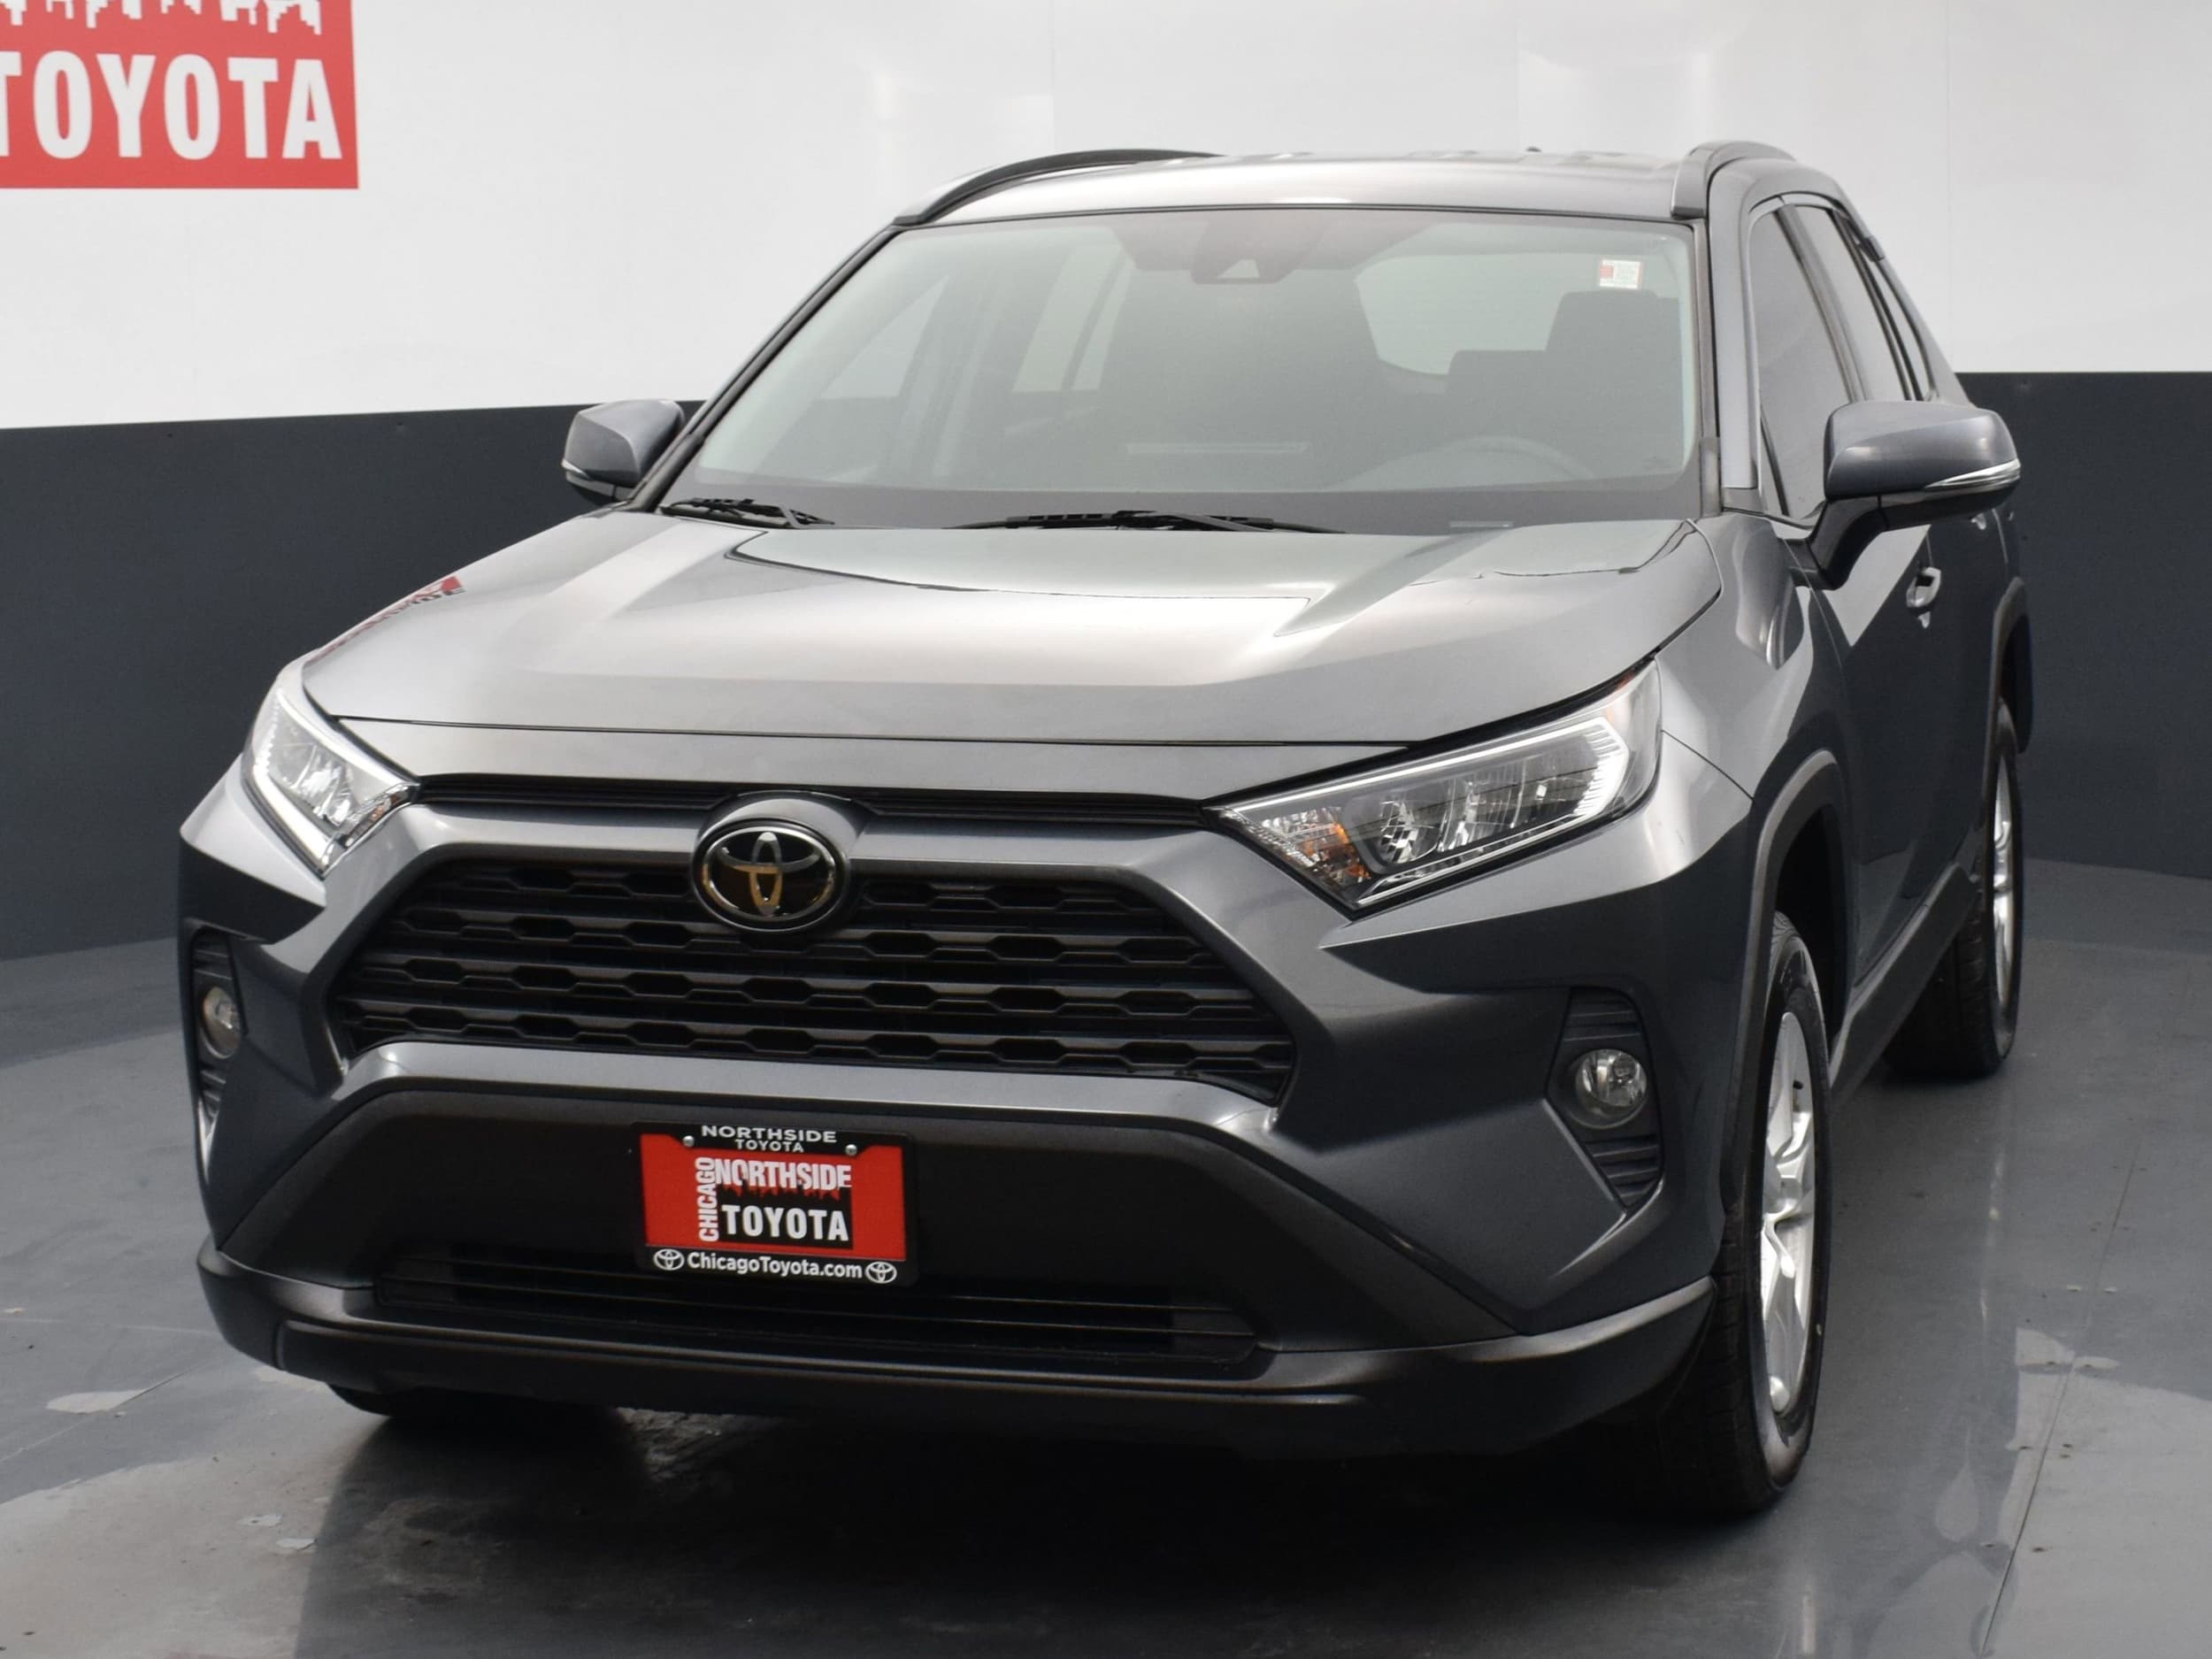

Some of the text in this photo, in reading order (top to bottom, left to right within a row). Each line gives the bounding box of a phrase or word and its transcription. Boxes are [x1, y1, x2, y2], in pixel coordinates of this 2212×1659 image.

[701, 1125, 837, 1143] NORTHSIDE
[735, 1139, 804, 1153] TOYOTA
[713, 1158, 852, 1191] NORTHSIDE
[695, 1156, 719, 1242] CHICAGO
[721, 1204, 849, 1241] TOYOTA
[687, 1251, 863, 1279] ChicagoToyota.com
